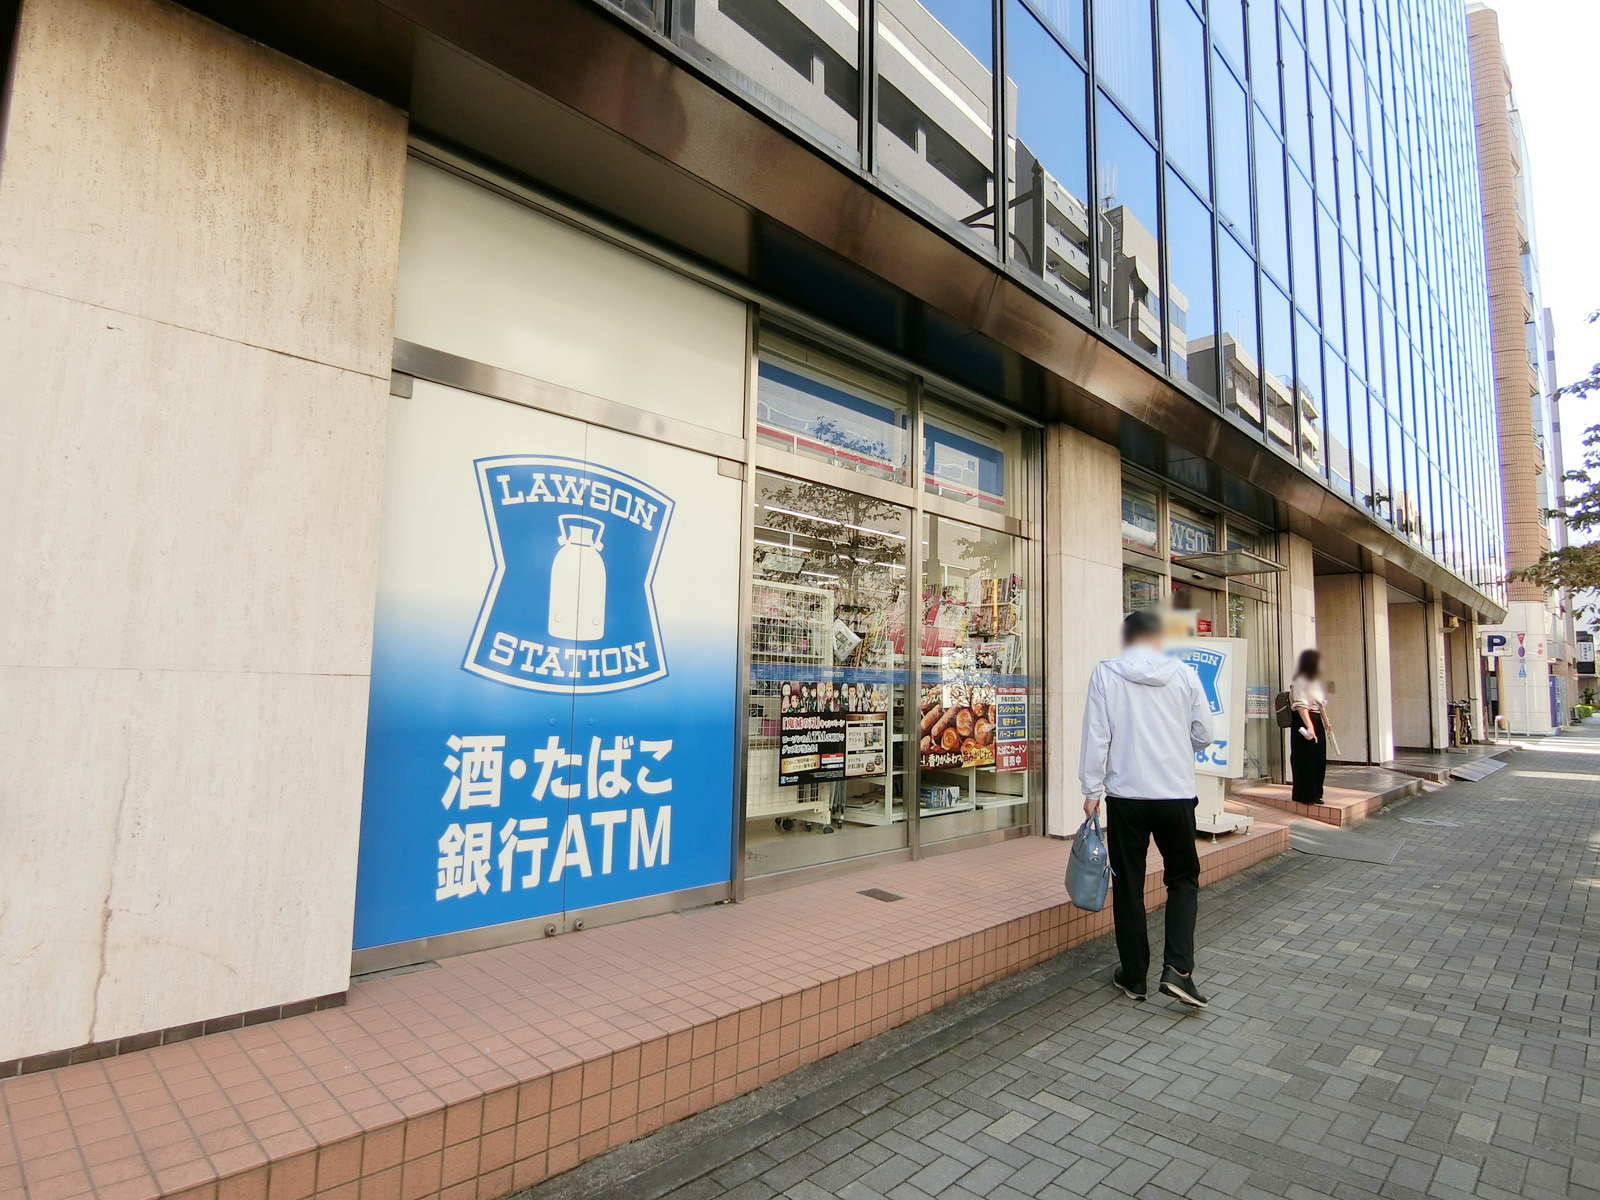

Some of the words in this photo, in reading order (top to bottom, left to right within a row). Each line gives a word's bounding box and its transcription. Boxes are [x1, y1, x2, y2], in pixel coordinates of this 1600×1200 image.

[497, 473, 659, 531] LAWSON
[489, 632, 649, 677] STATION
[1487, 635, 1506, 652] P
[441, 734, 673, 811] 酒・たばこ
[997, 745, 1027, 755] たばこカートン
[1002, 756, 1021, 767] 販売中
[436, 805, 672, 901] 銀行ATM
